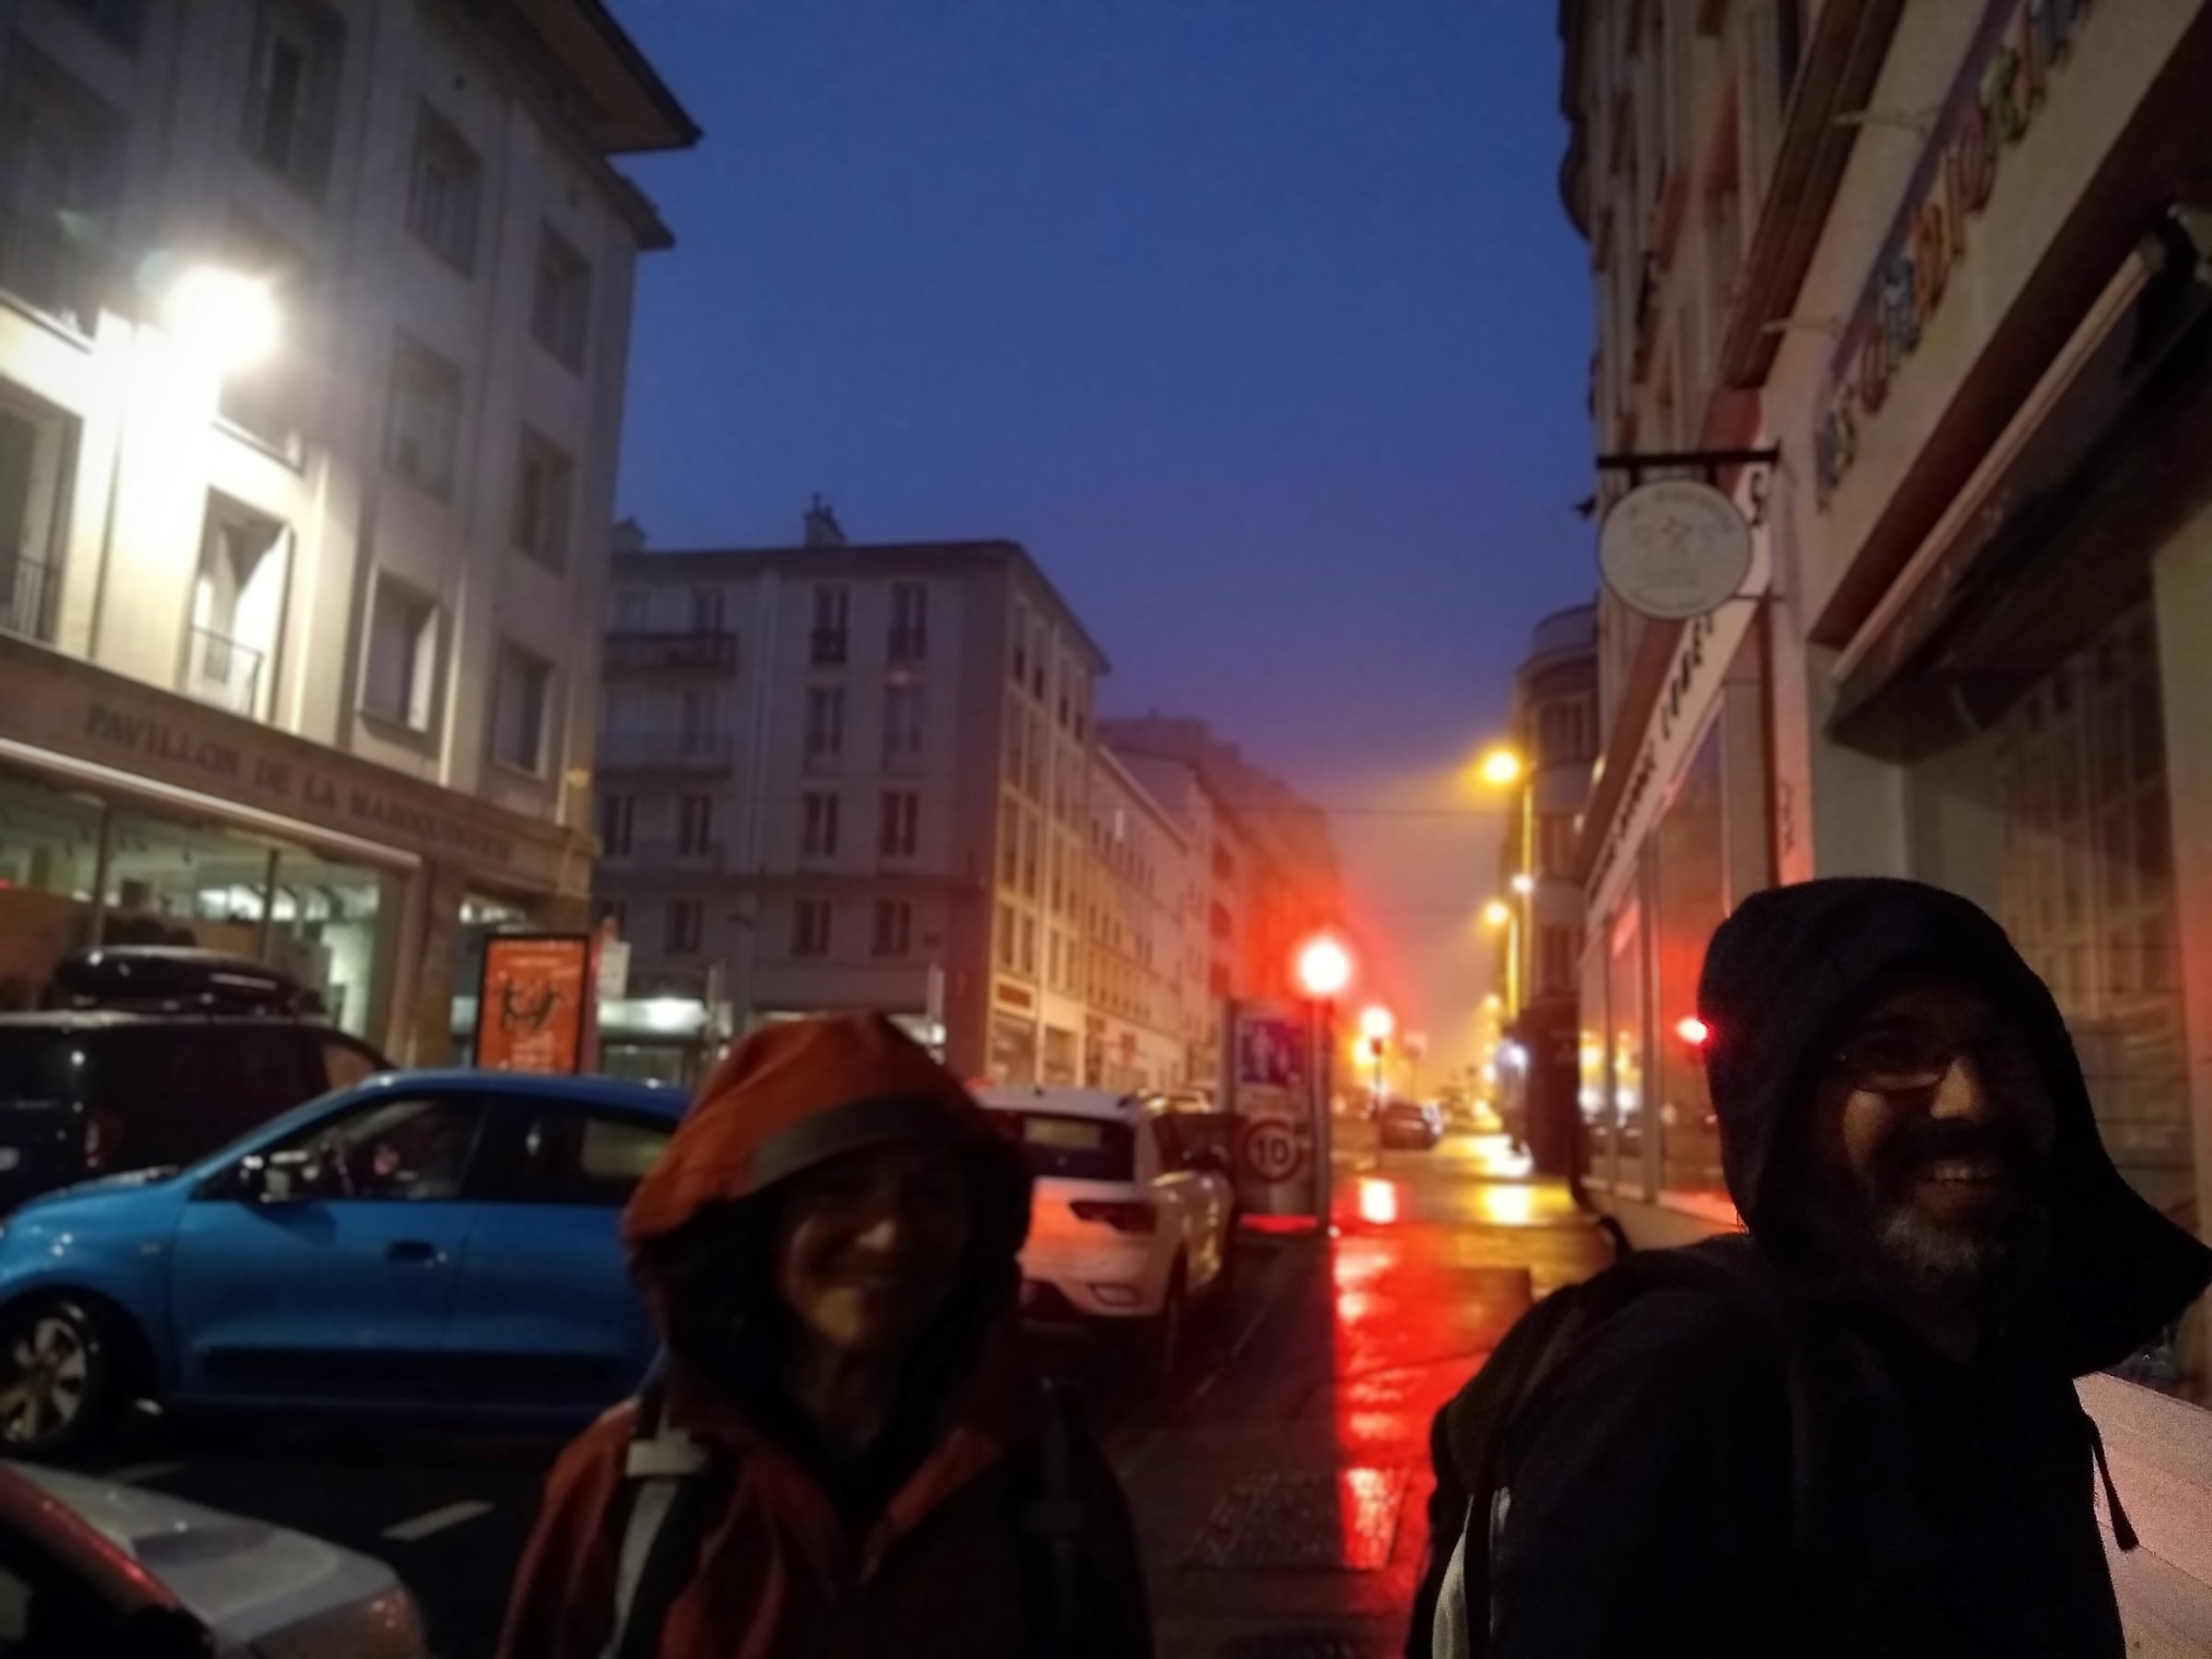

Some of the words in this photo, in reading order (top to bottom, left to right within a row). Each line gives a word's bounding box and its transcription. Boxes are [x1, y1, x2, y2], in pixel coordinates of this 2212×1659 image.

[86, 702, 239, 779] PAVILLON
[255, 758, 292, 794] DE
[304, 772, 339, 810] LA
[1255, 1136, 1289, 1166] 10
